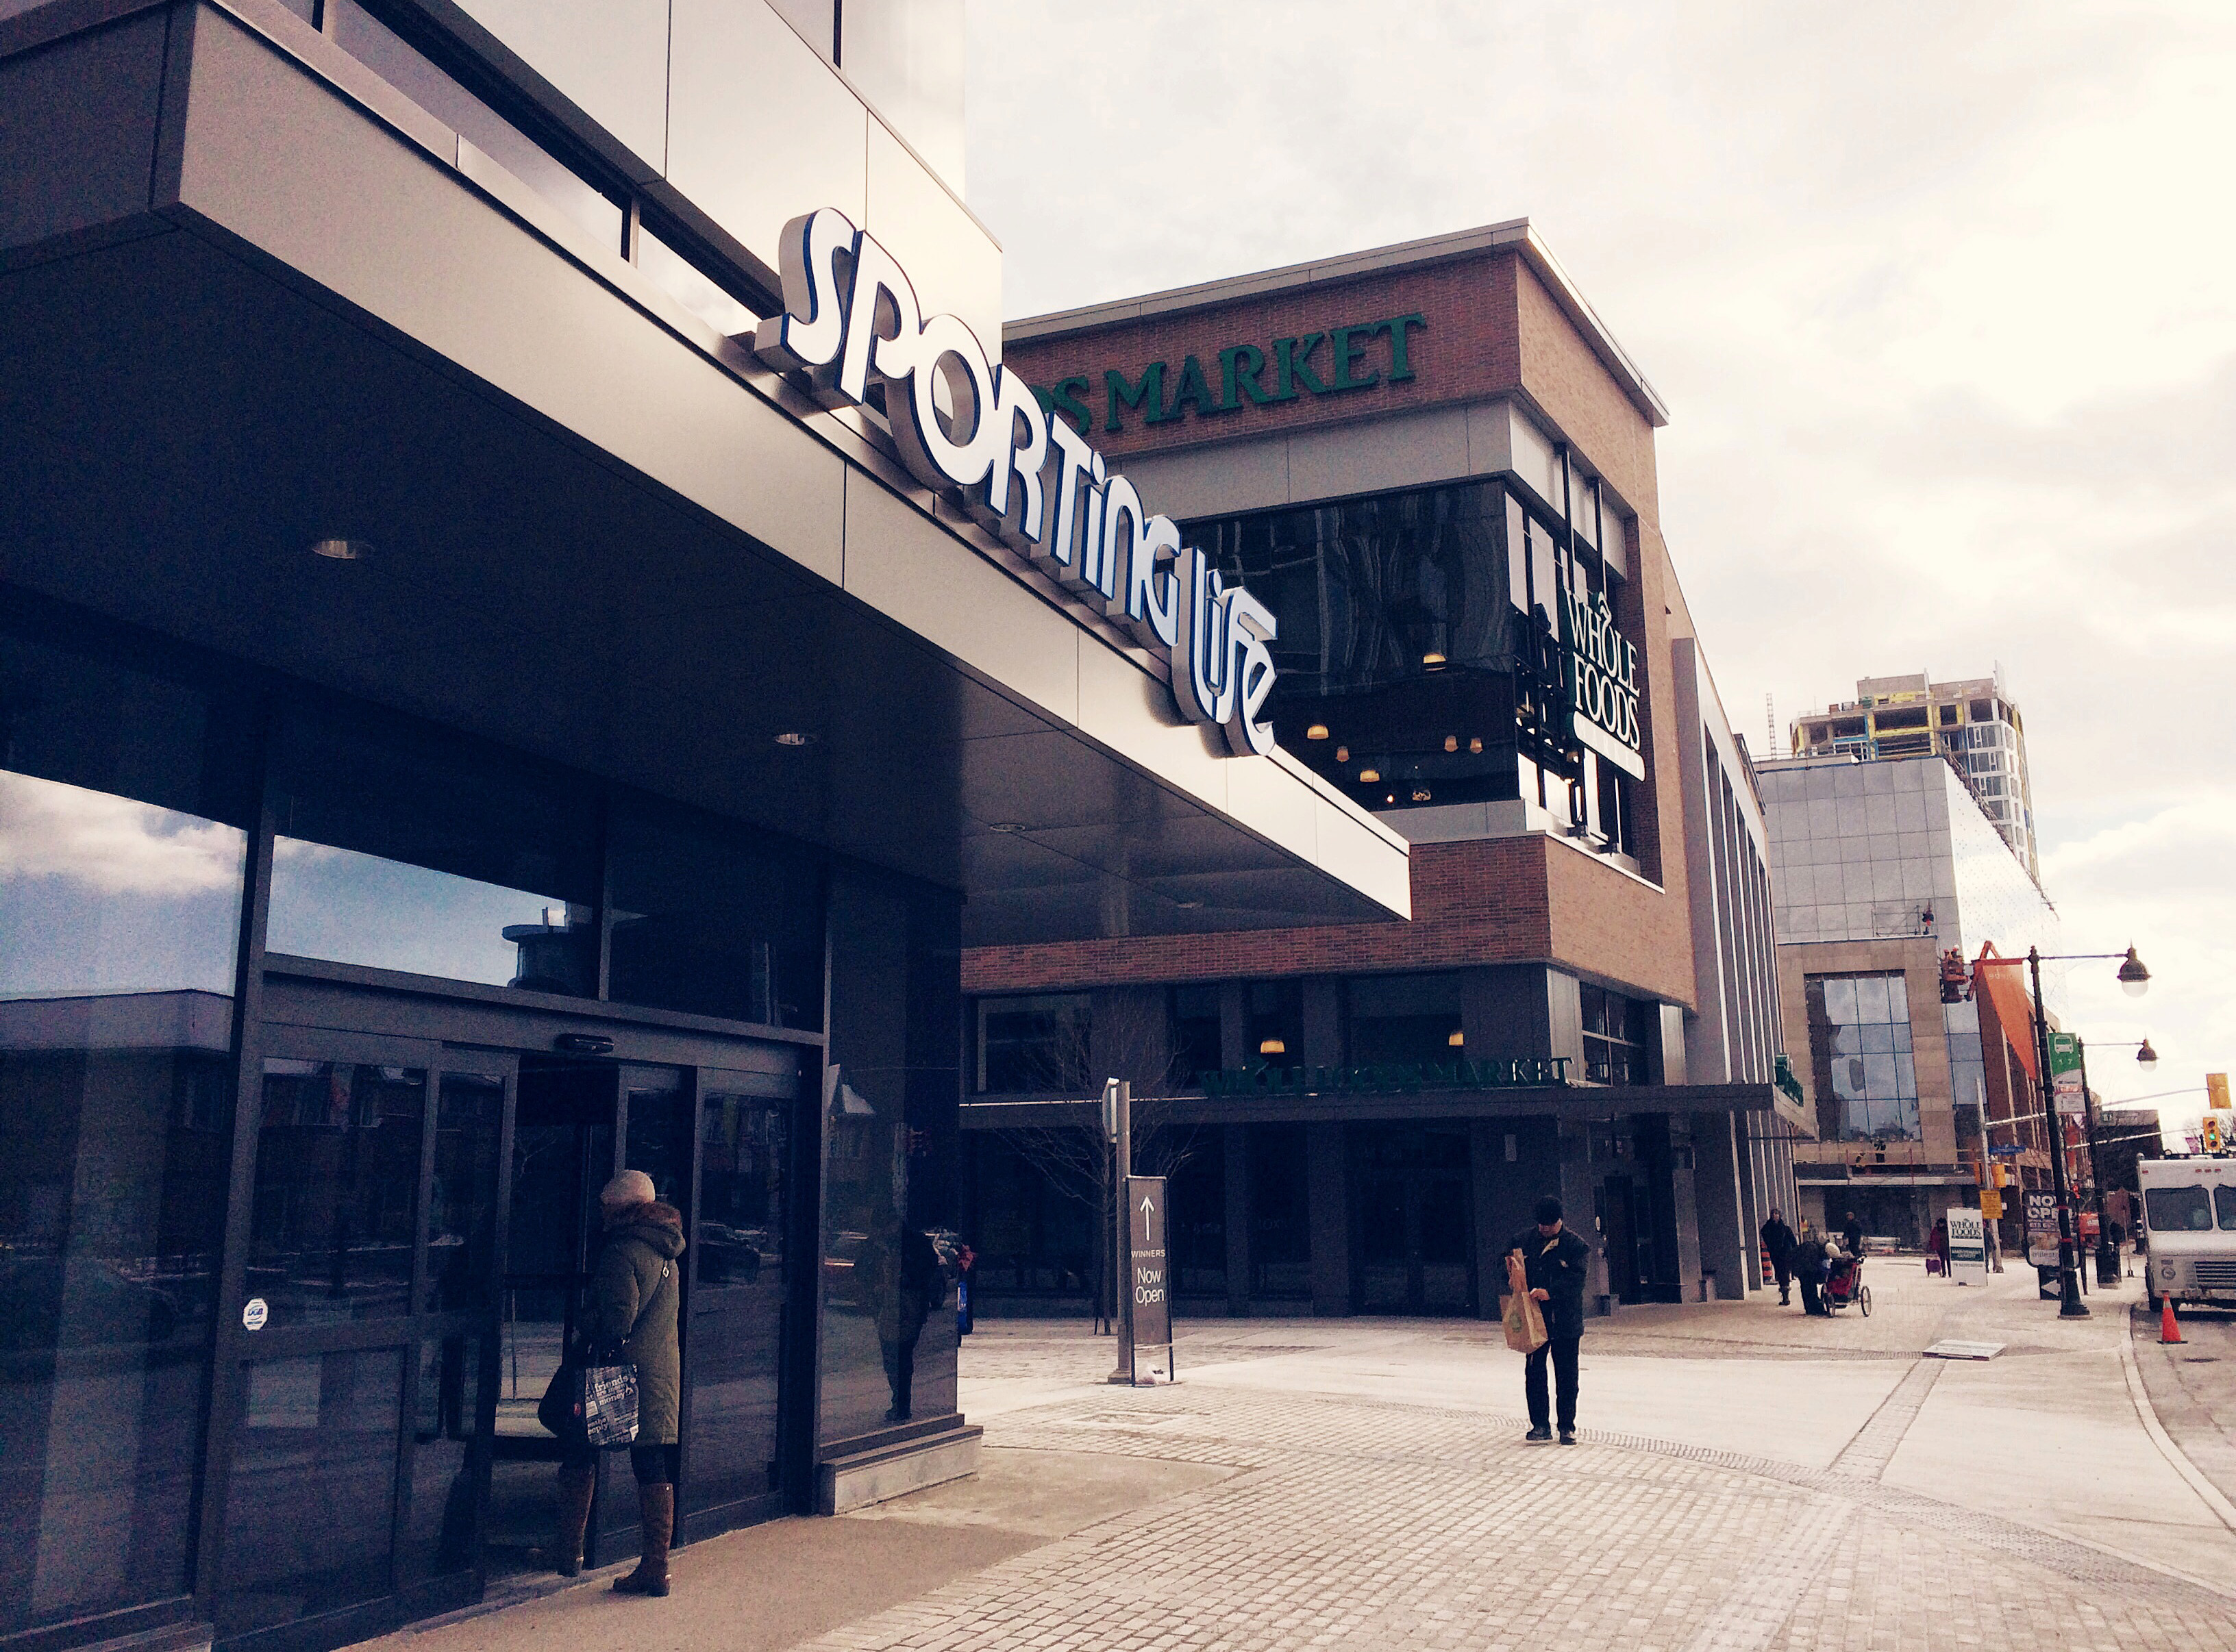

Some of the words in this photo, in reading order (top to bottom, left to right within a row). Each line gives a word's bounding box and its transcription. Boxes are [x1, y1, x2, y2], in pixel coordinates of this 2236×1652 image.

[1104, 312, 1428, 432] MARKET
[1563, 587, 1640, 698] WHOLE
[1573, 651, 1641, 751] FOODS
[1950, 1221, 1981, 1229] WHOLE
[1952, 1227, 1981, 1236] FOODS
[1131, 1249, 1165, 1258] WINNERS
[1137, 1267, 1161, 1284] Now
[1135, 1286, 1165, 1307] Open
